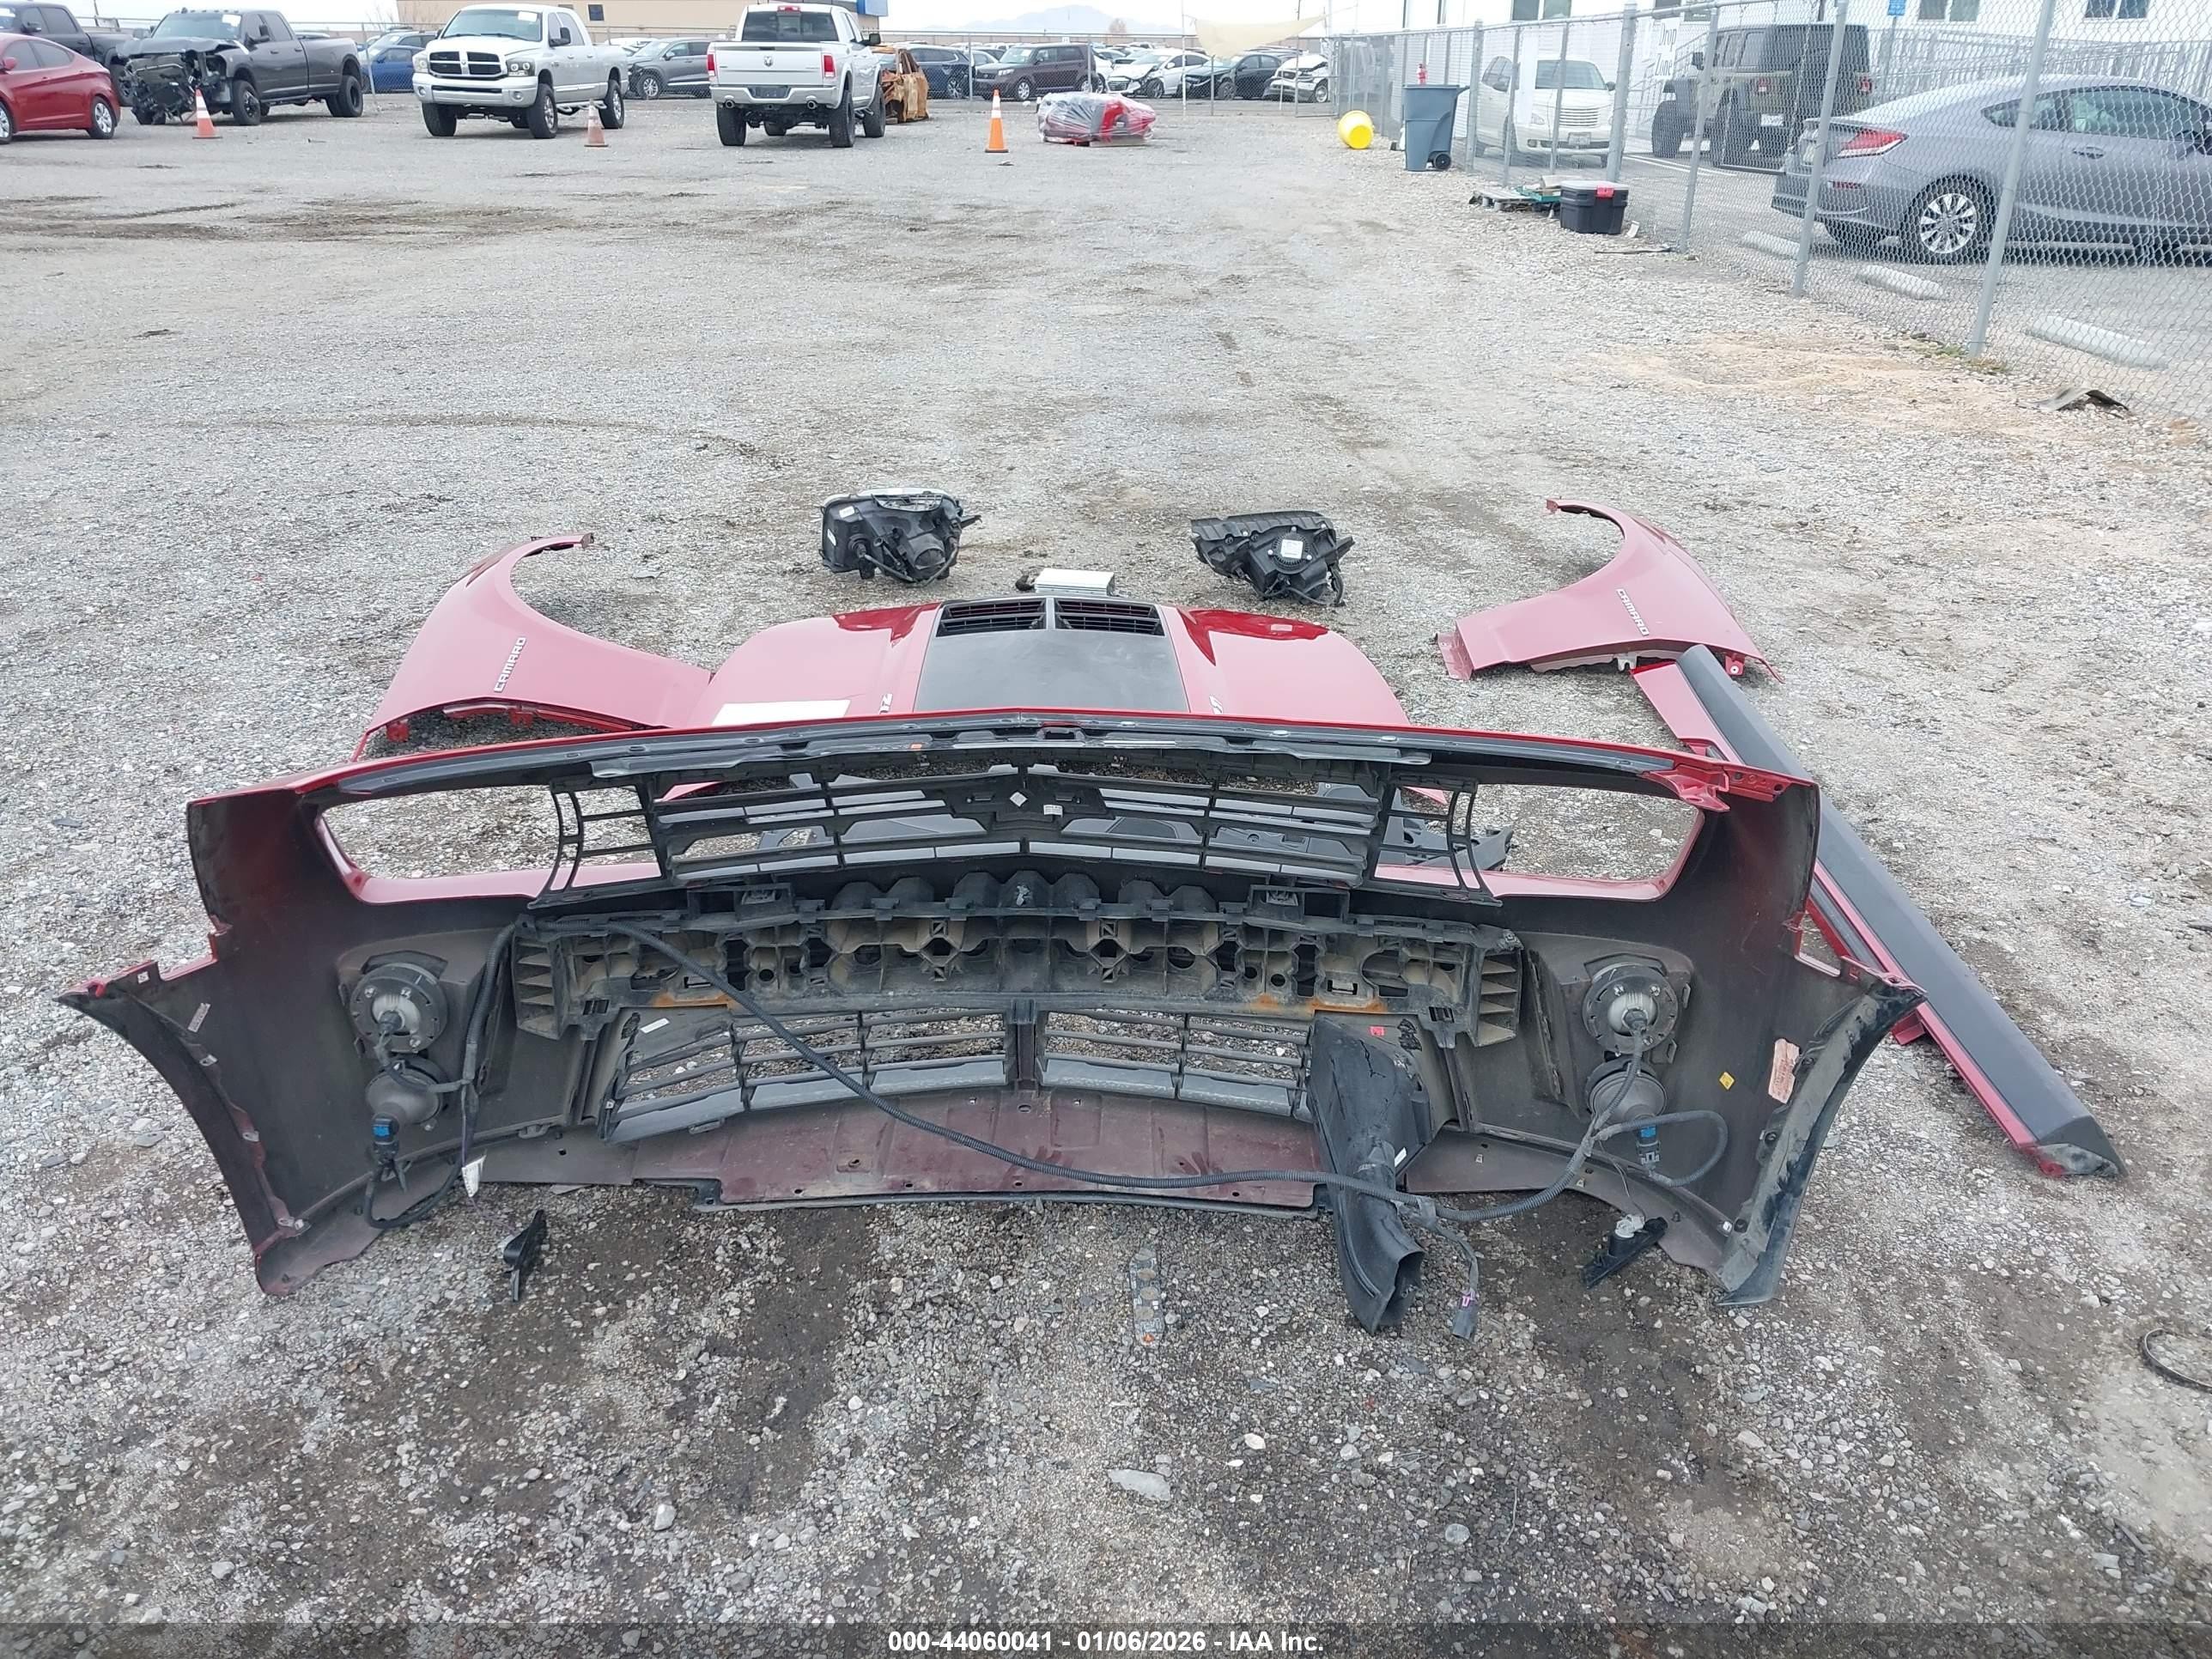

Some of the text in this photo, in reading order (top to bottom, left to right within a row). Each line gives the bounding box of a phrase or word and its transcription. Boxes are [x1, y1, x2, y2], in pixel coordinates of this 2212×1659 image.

[1658, 22, 1677, 52] Drop
[1655, 52, 1673, 76] Zone
[1616, 588, 1650, 636] CAMARO
[494, 636, 526, 693] CAMARO
